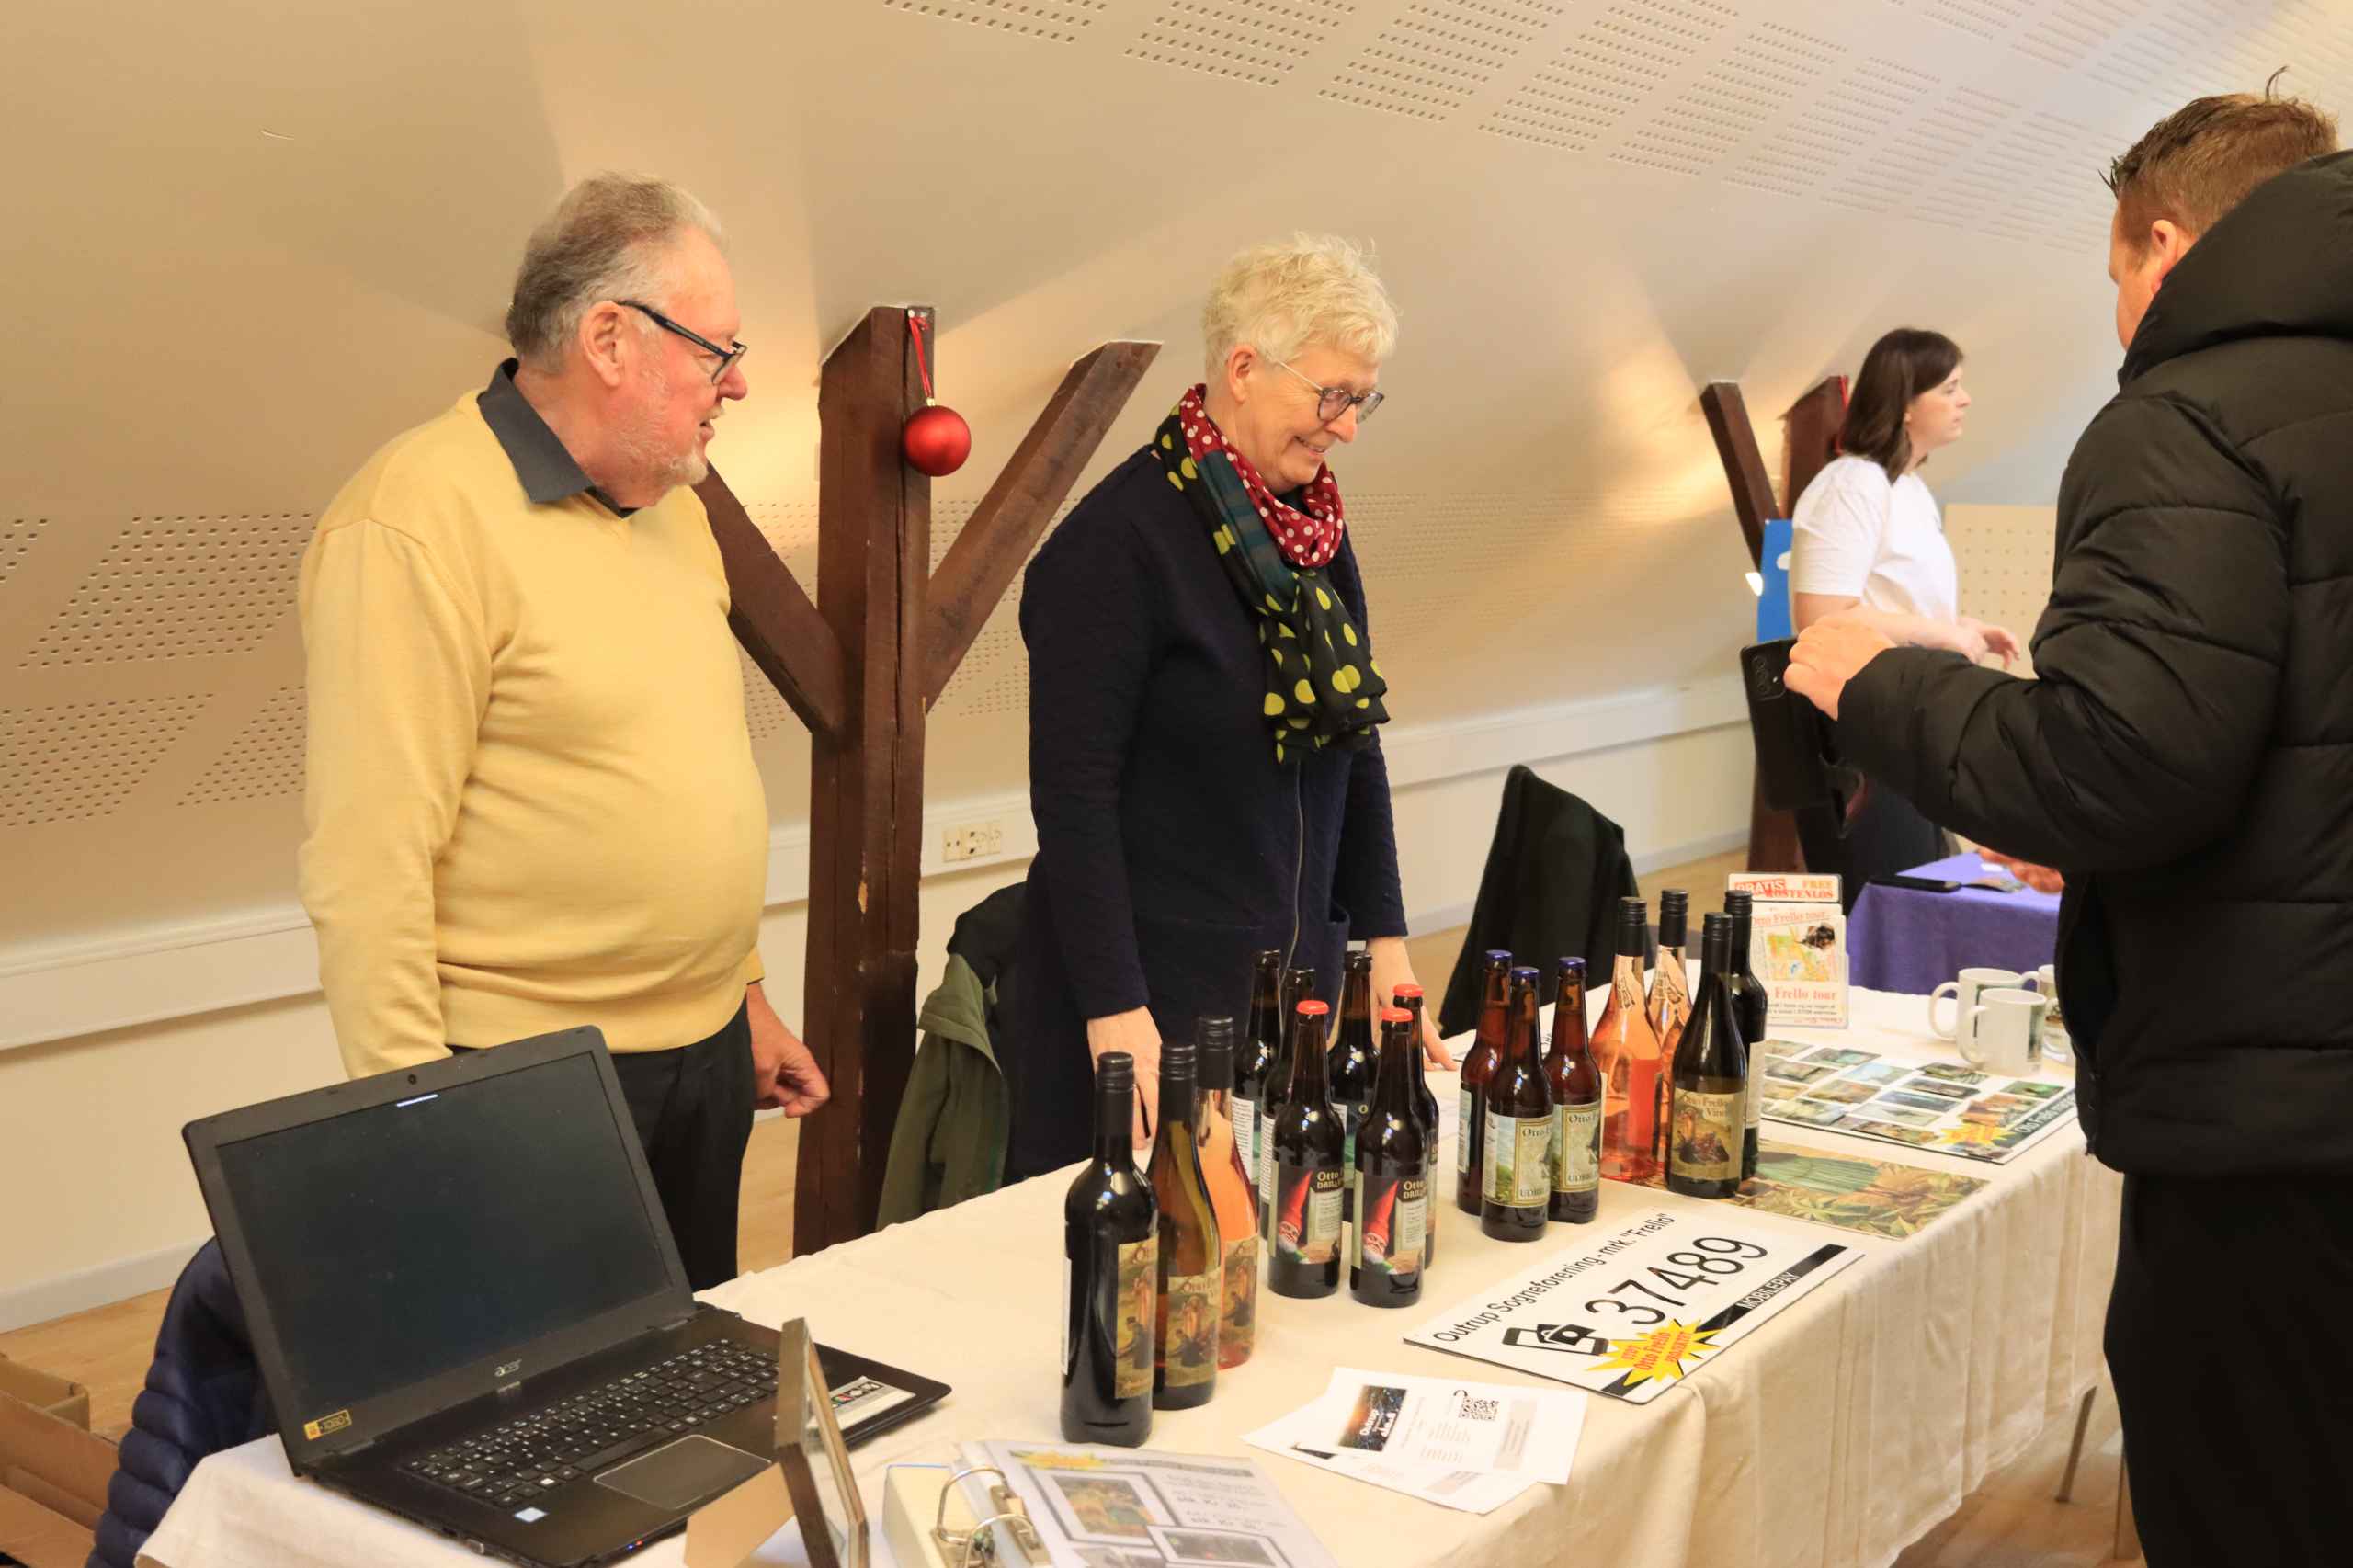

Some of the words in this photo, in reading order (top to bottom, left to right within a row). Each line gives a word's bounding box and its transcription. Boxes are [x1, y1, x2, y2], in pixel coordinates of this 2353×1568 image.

[1775, 986, 1809, 1000] Frello
[1813, 989, 1836, 1000] tour
[1433, 1312, 1502, 1342] Outrup
[1486, 1256, 1607, 1312] Sogneforening
[1584, 1236, 1768, 1324] 37489
[1735, 1271, 1802, 1310] MOBILEPAY
